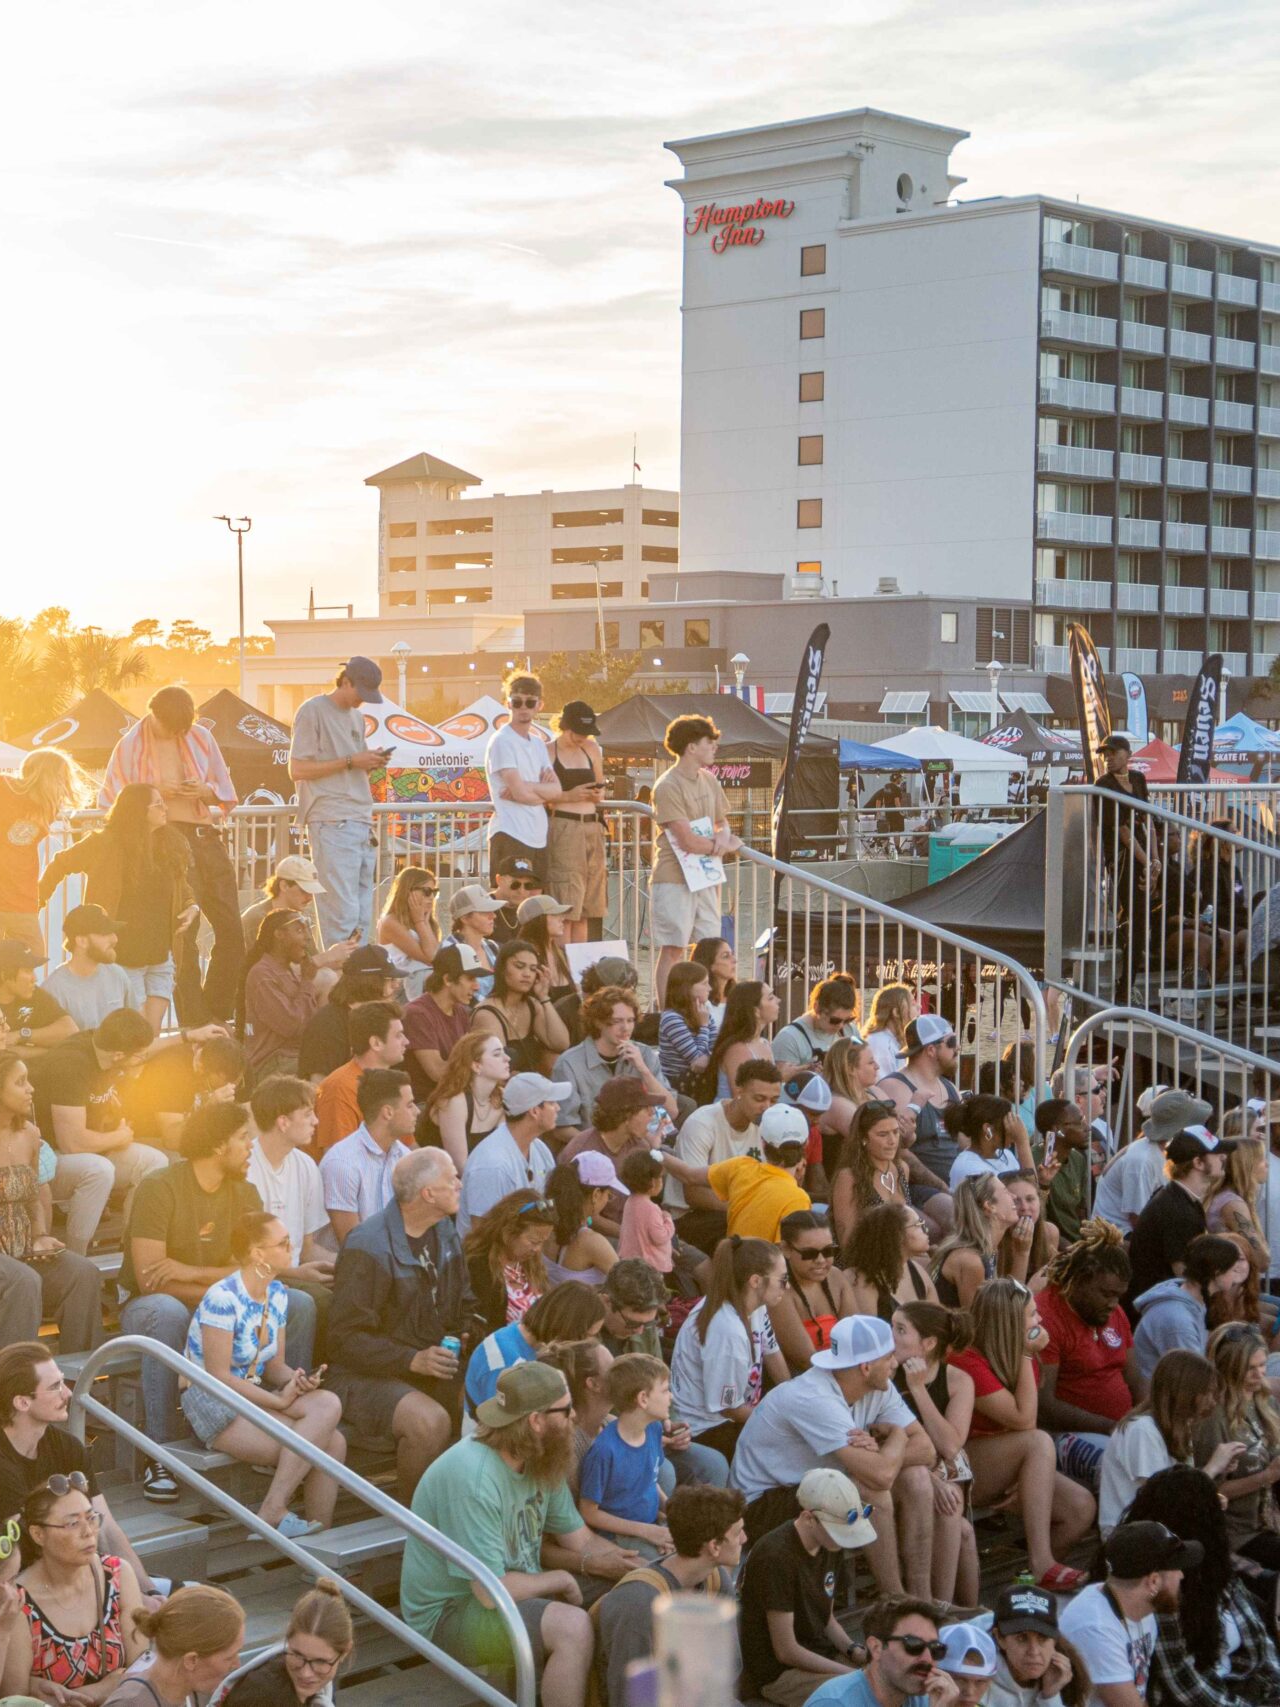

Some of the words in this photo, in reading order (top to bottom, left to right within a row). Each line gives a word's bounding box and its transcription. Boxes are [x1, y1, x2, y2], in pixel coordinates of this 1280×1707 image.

[685, 197, 795, 235] Hampton
[711, 223, 764, 254] Inn
[1193, 673, 1217, 761] Seven
[720, 764, 751, 779] JOINTS
[1213, 753, 1236, 762] SKATE
[1238, 753, 1249, 762] IT.
